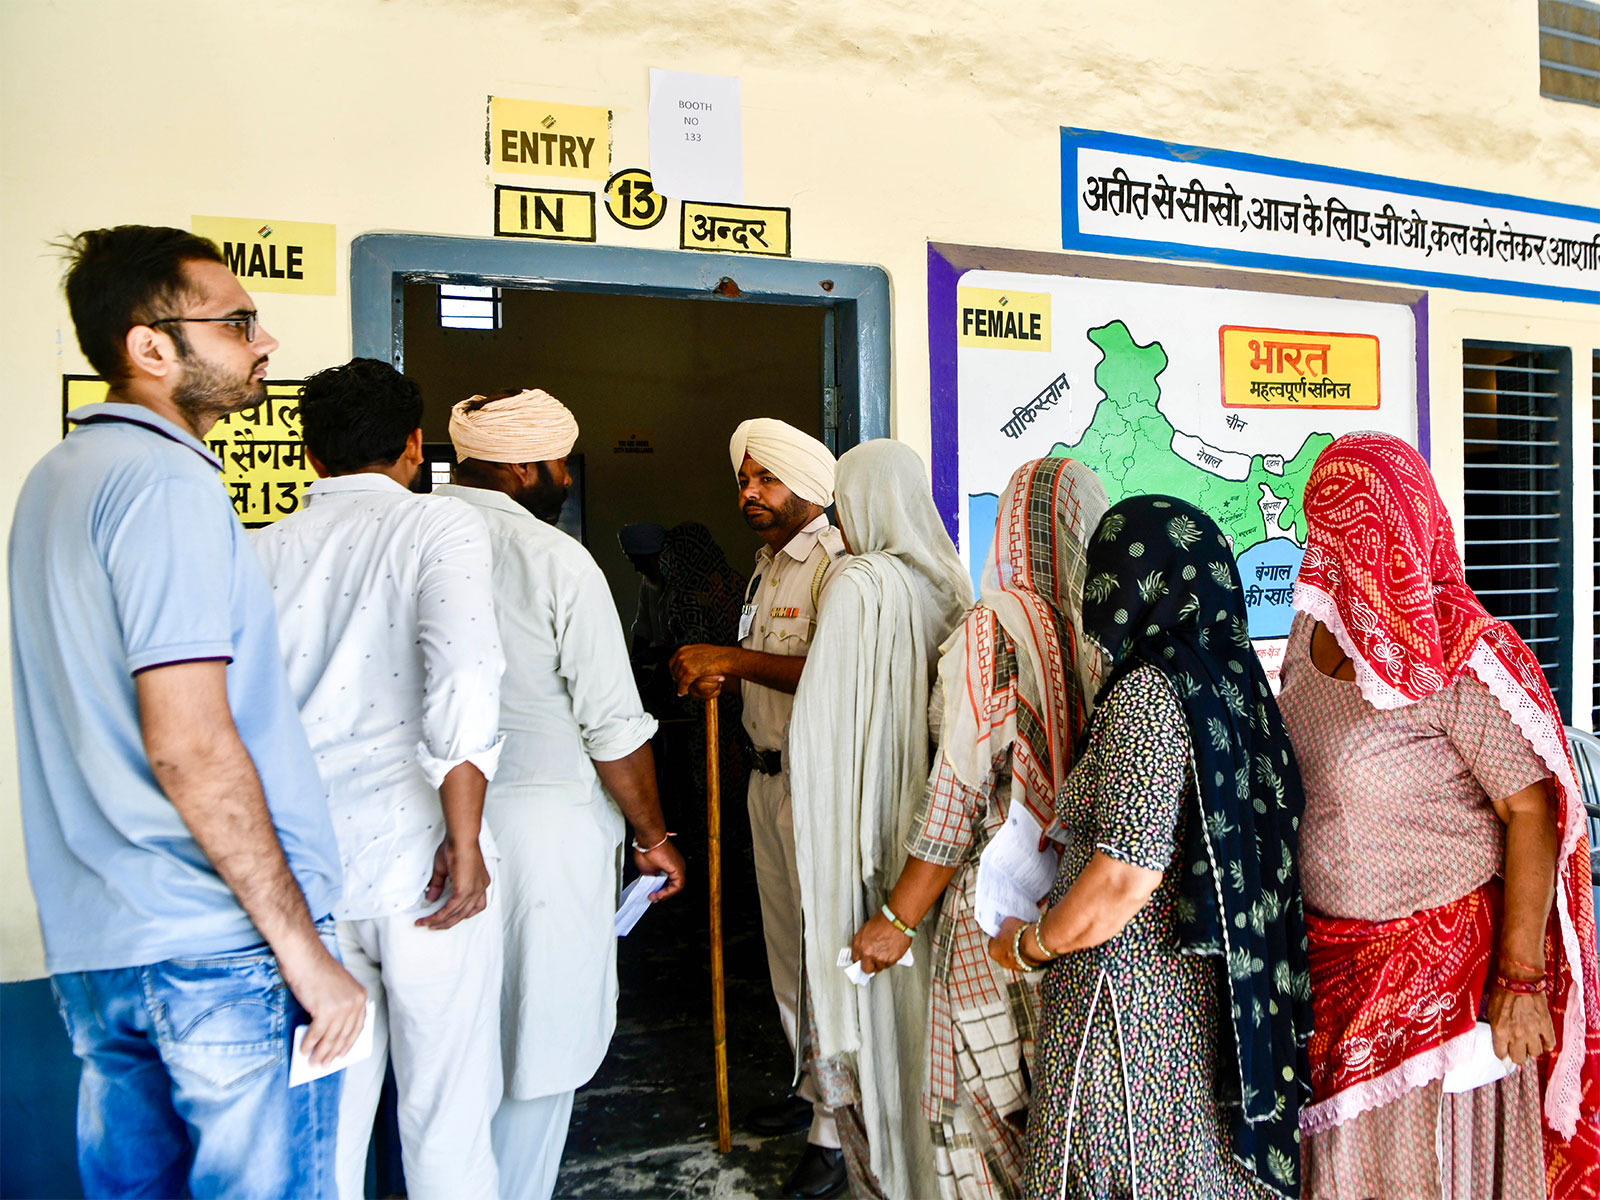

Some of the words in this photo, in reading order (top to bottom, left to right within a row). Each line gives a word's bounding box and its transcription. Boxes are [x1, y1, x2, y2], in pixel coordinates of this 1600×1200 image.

[678, 100, 713, 112] BOOTH
[684, 116, 699, 126] NO
[501, 129, 595, 169] ENTRY
[684, 132, 702, 142] 133
[520, 195, 564, 233] IN
[618, 179, 656, 219] 13
[690, 214, 769, 249] अन्दर
[1083, 167, 1151, 220] अतीत
[1152, 174, 1176, 219] से
[1303, 194, 1323, 236] के
[1325, 197, 1371, 248] लिए
[1470, 218, 1497, 258] को
[1496, 221, 1546, 265] लेकर
[224, 242, 303, 280] MALE
[963, 308, 1041, 340] FEMALE
[1248, 340, 1331, 377] भारत
[1308, 377, 1351, 399] खनिज
[1000, 372, 1070, 439] पाकिस्तान
[1226, 414, 1248, 432] चीन
[1197, 447, 1223, 468] नेपाल
[261, 481, 314, 515] 13
[1255, 562, 1293, 582] बंगाल
[1245, 584, 1264, 608] की
